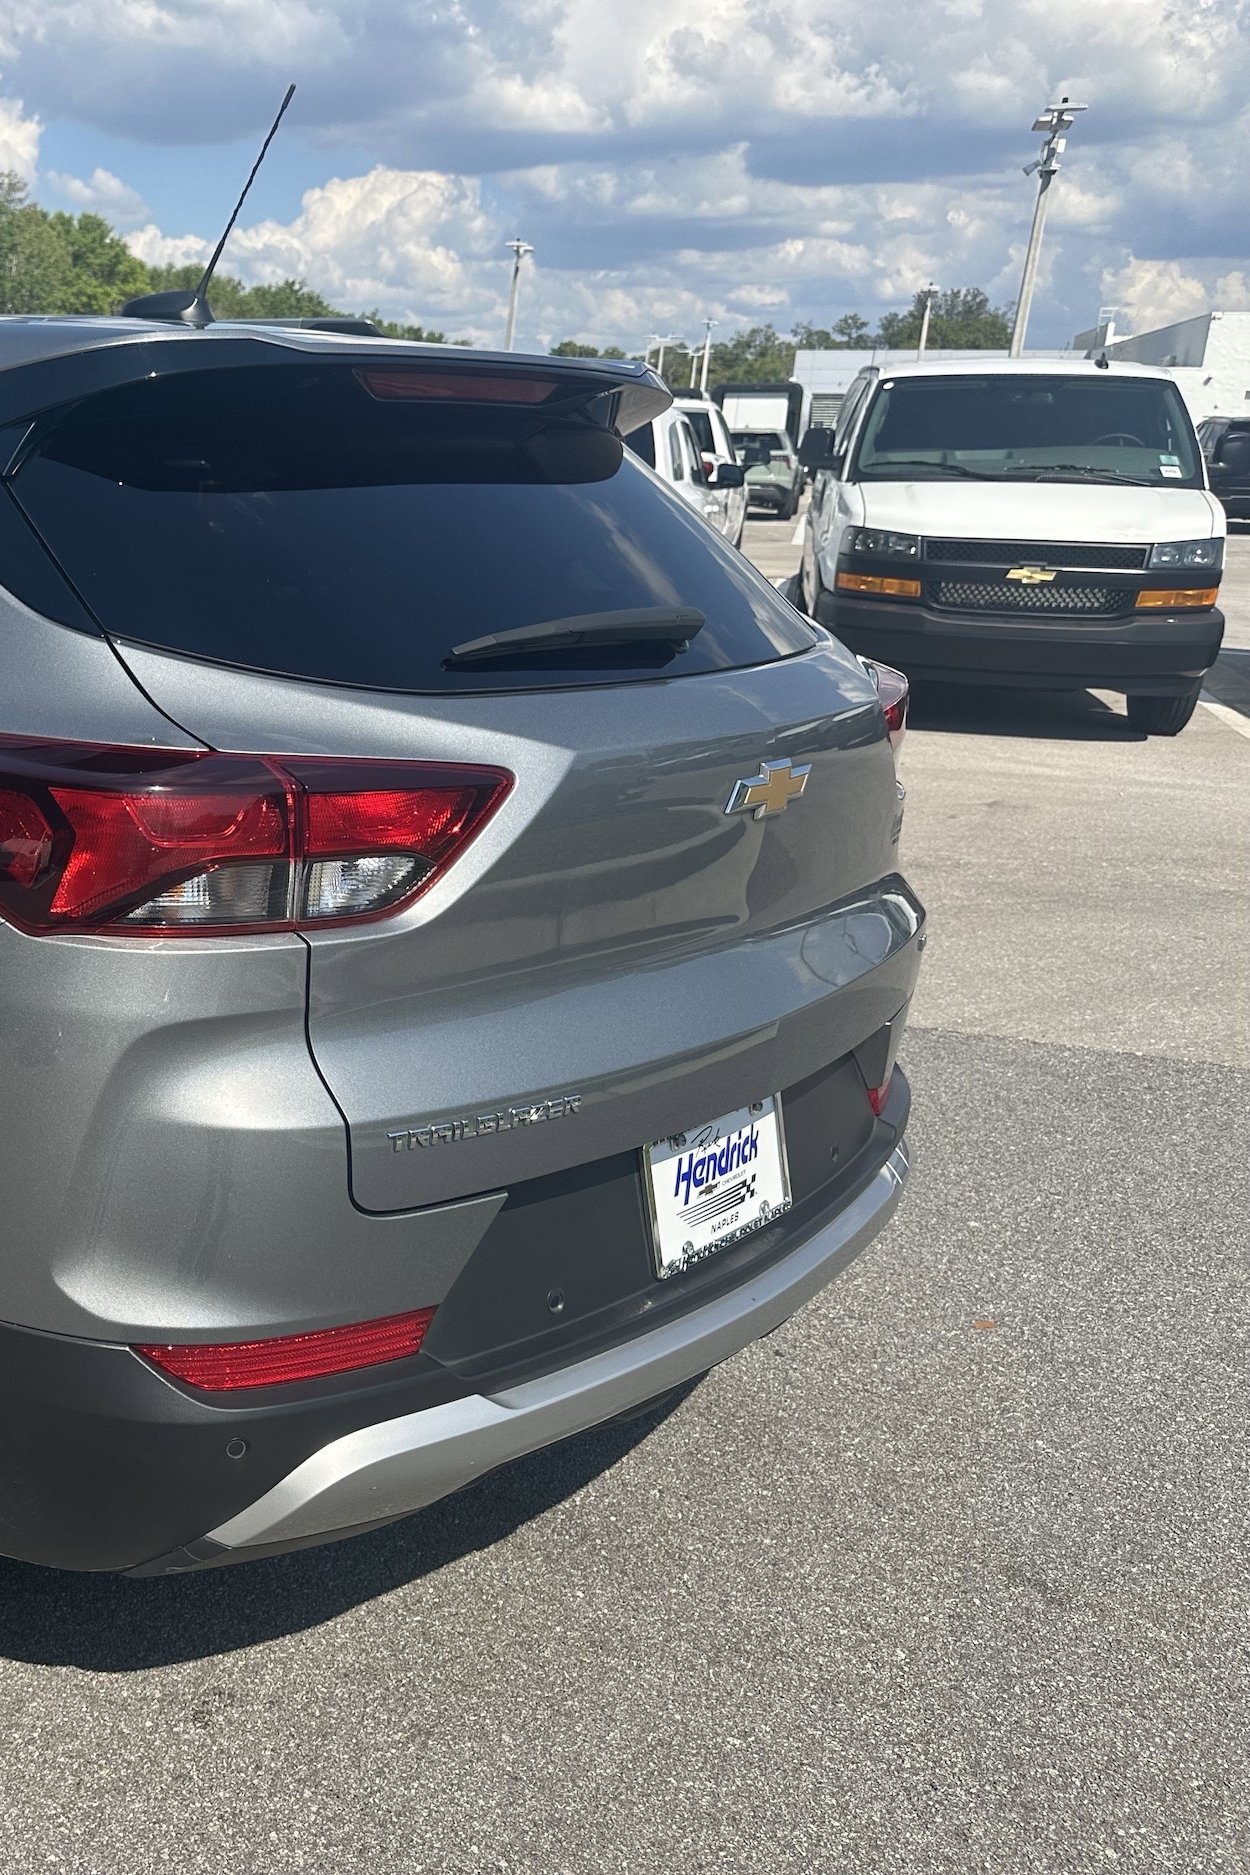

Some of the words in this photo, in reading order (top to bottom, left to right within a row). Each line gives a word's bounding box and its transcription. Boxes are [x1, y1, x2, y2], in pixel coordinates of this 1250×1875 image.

[387, 1094, 582, 1153] TRAILBLAZER
[673, 1123, 760, 1207] Hendrick
[721, 1168, 747, 1187] CHEVROLET
[710, 1210, 740, 1235] NAPLES
